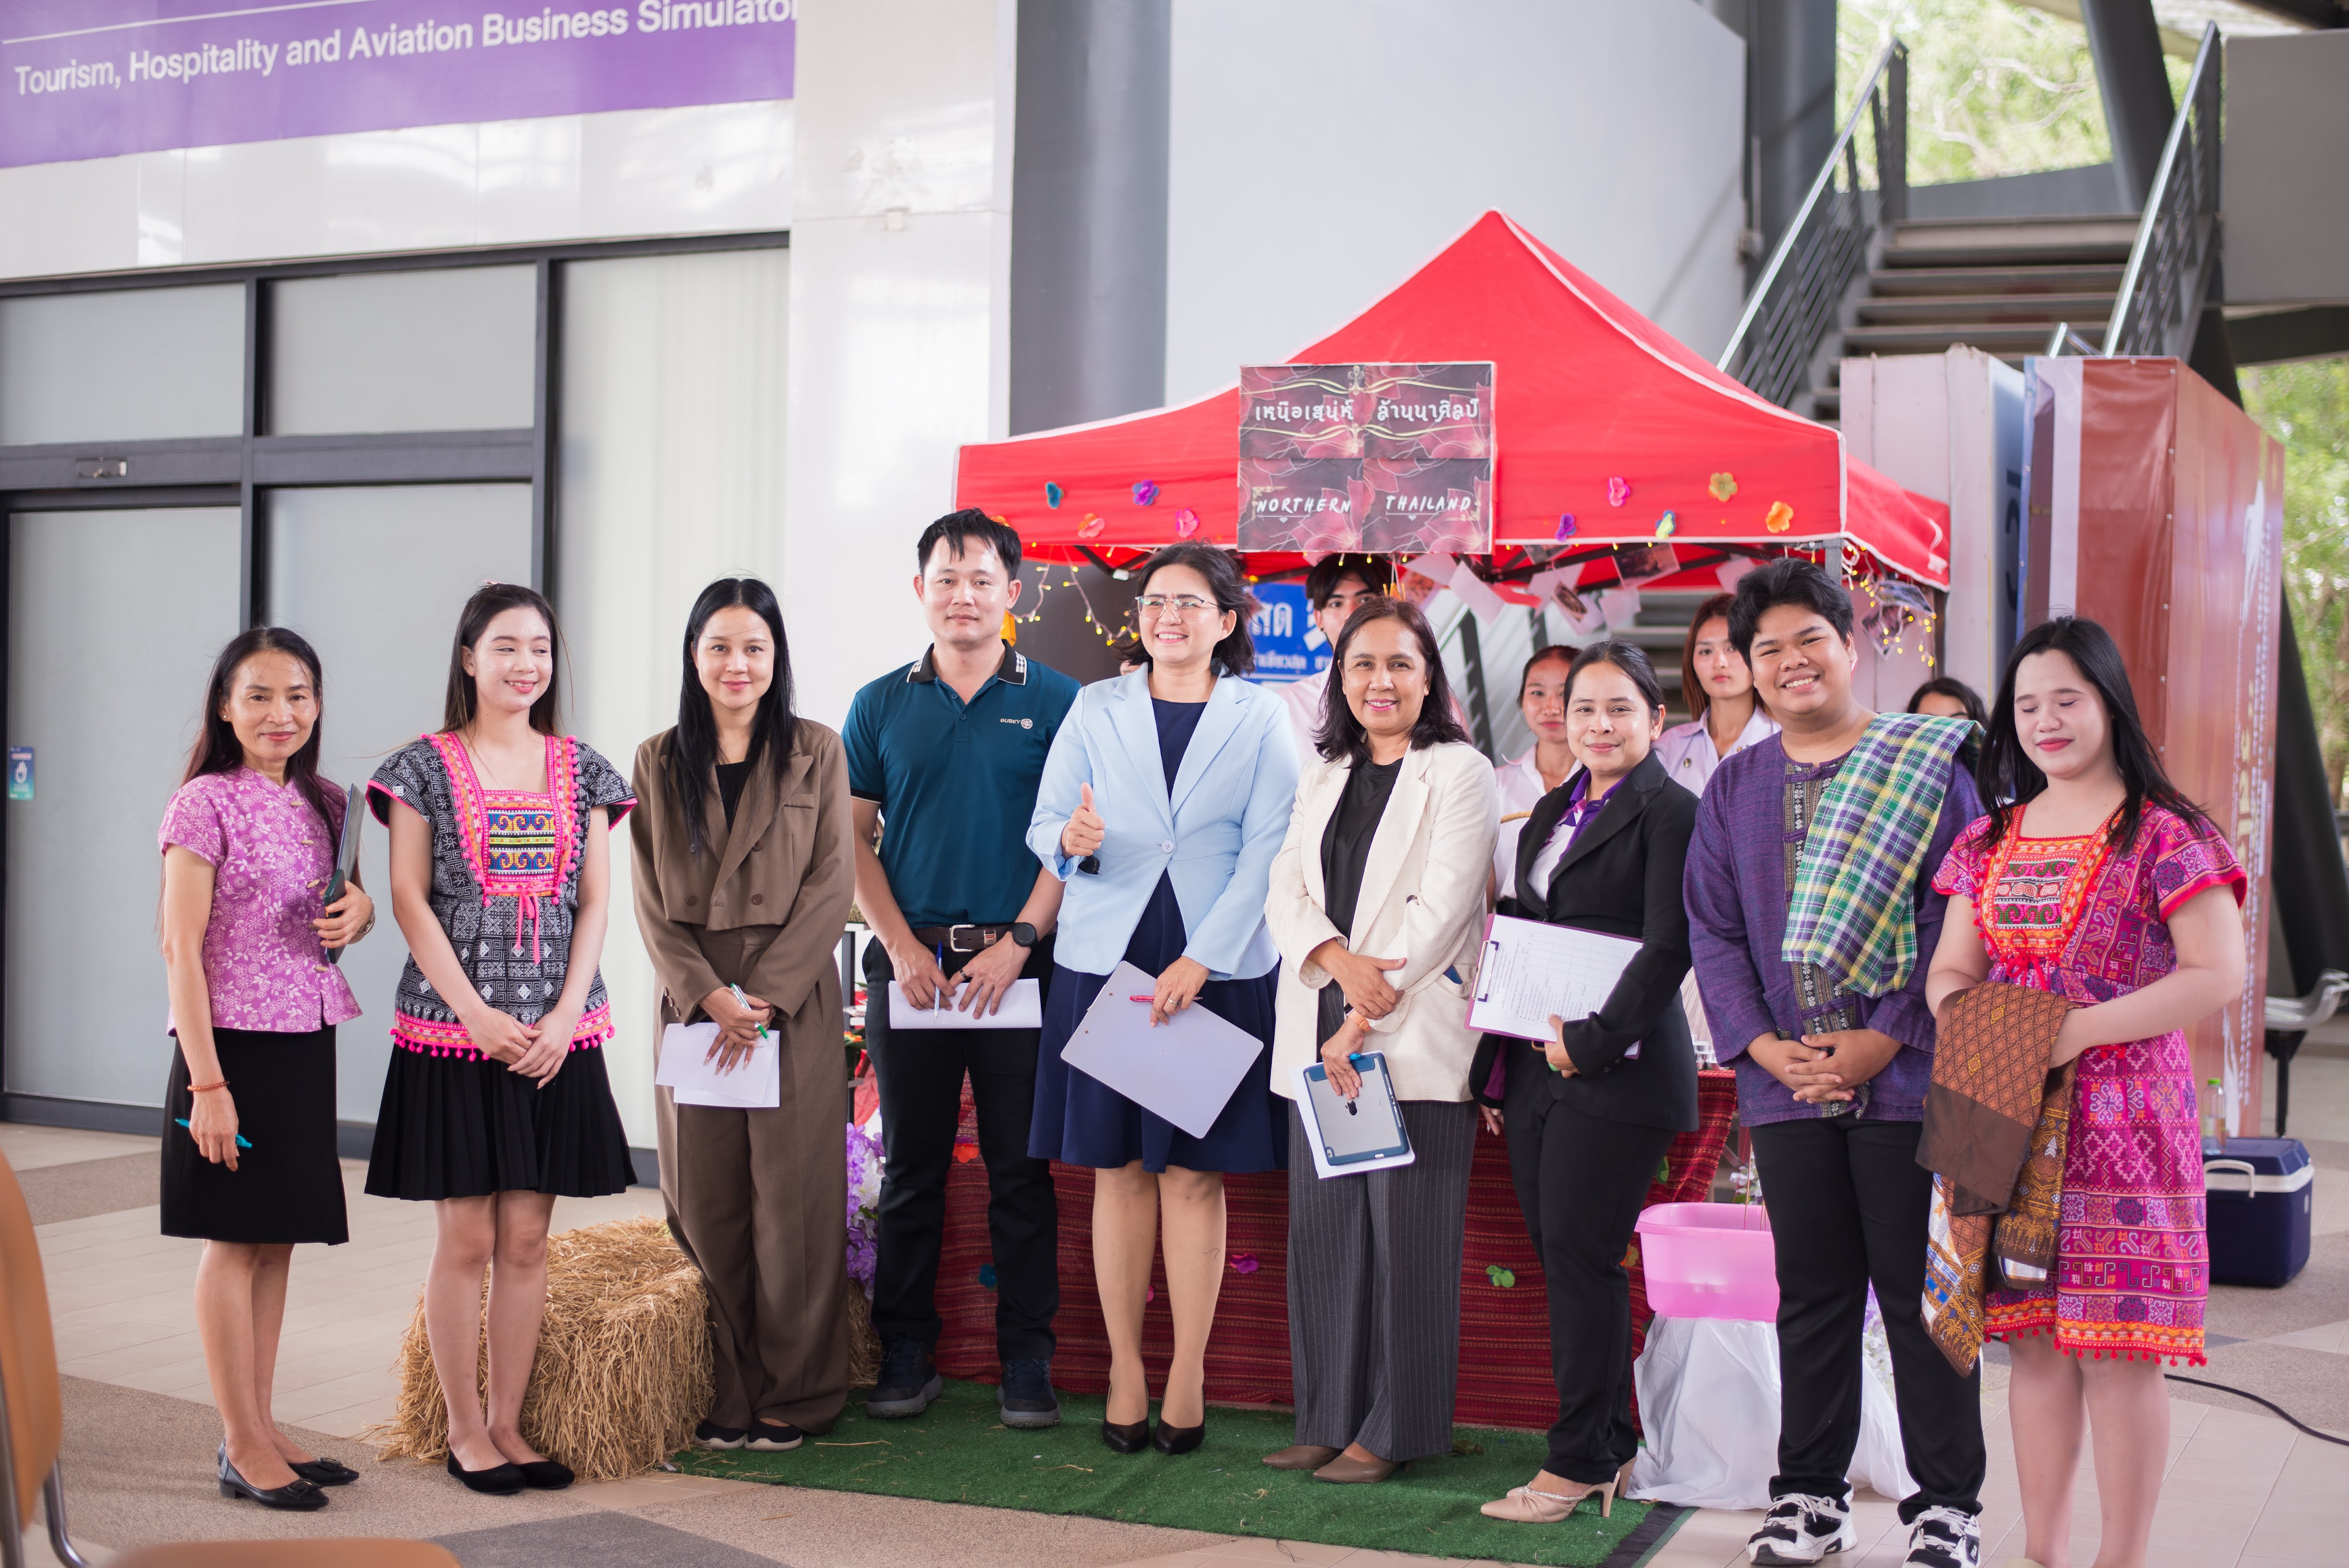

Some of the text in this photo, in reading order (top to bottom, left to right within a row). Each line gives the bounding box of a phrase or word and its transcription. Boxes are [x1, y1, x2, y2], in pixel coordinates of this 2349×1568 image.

[14, 59, 121, 96] Tourism,
[129, 38, 280, 84] Hospitality
[286, 29, 341, 66] and
[348, 19, 474, 61] Aviation
[482, 7, 630, 48] Business
[1256, 495, 1472, 514] NORTHERN THAILAND
